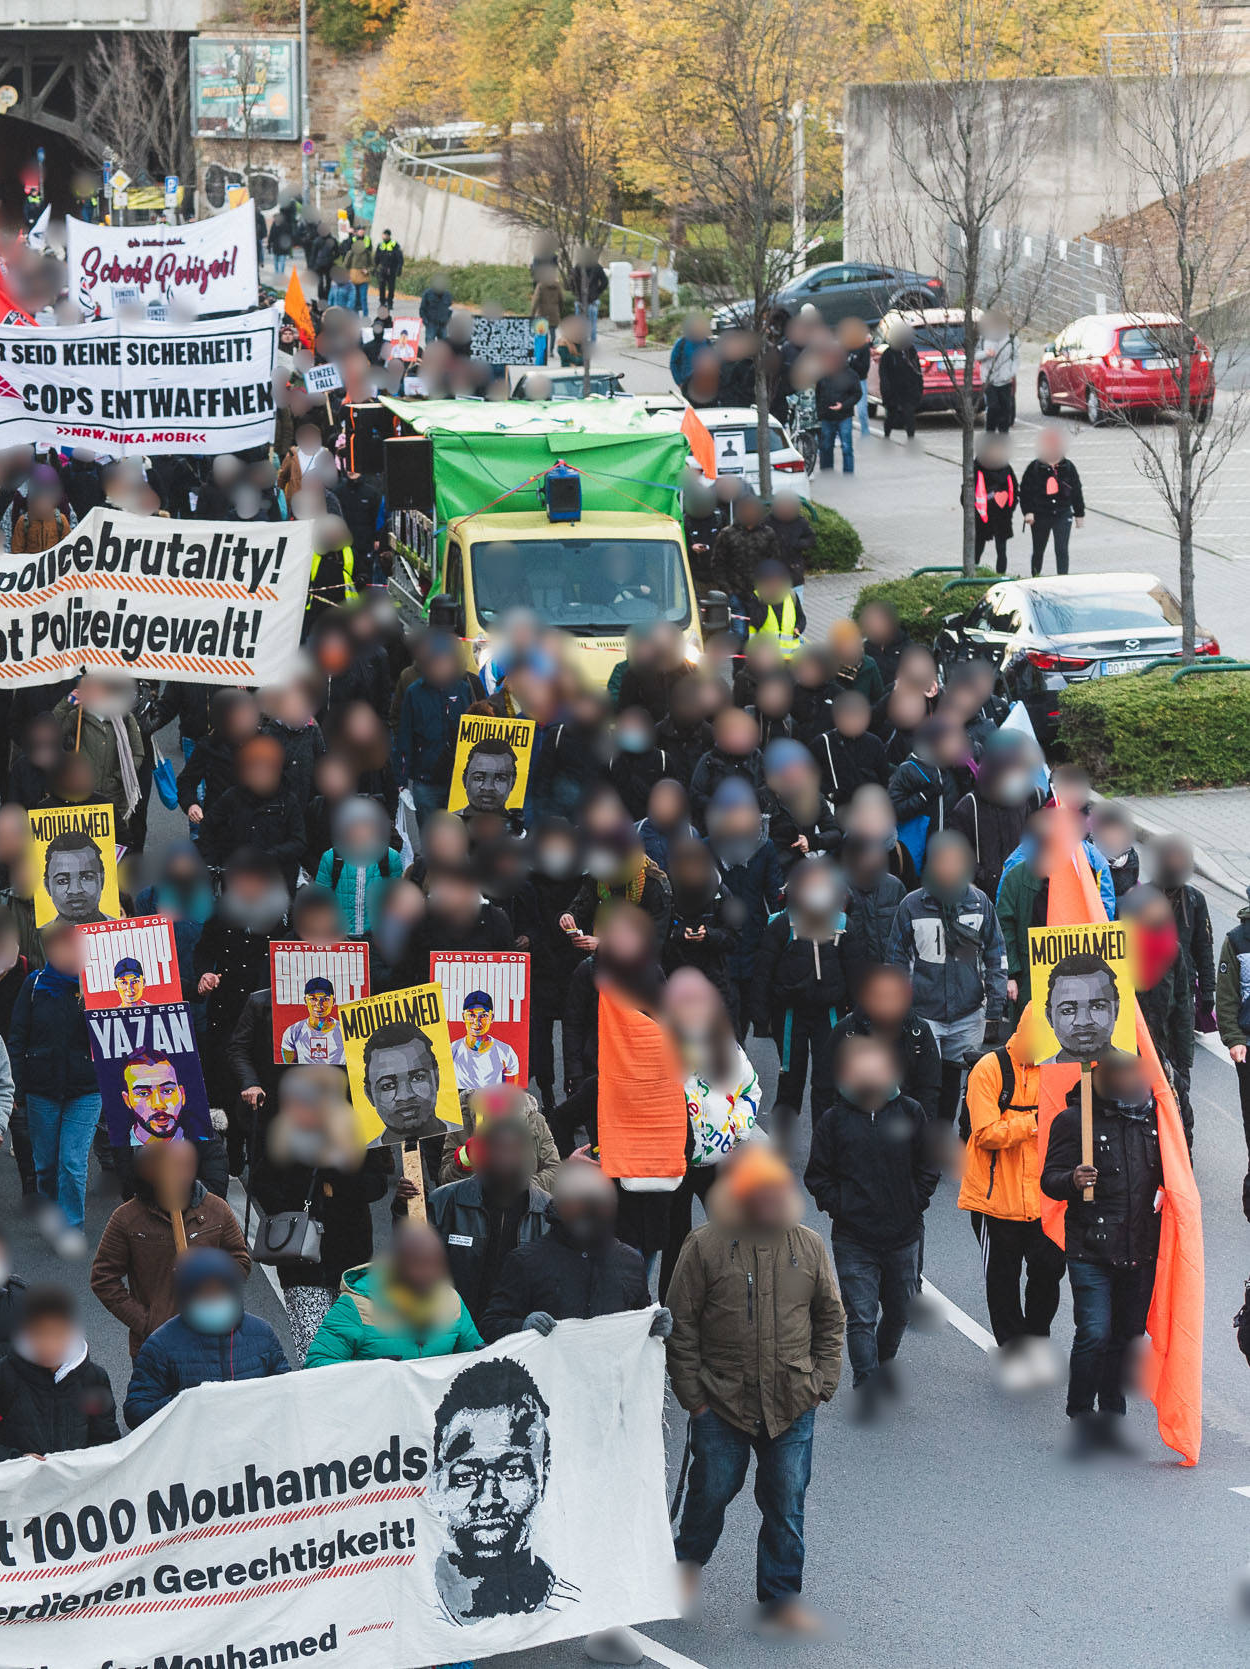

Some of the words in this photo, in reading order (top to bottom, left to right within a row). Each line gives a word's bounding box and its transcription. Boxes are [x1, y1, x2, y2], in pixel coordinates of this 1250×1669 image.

[12, 344, 56, 366] SEID
[62, 342, 121, 366] KEINE
[127, 337, 253, 366] SICHERHEIT!
[308, 366, 336, 382] EINZEL
[315, 378, 335, 390] FALL
[22, 383, 94, 415] COPS
[101, 381, 275, 419] ENTWAFFNEN
[96, 521, 288, 594] brutality!
[31, 597, 263, 662] Polizeigewalt!
[459, 721, 530, 748] MOUHAMED
[31, 811, 110, 842] MOUHAMED
[81, 921, 137, 934] JUSTICE
[143, 917, 168, 927] FOR
[1046, 927, 1089, 935] JUSTICE
[501, 954, 526, 962] FOR
[1031, 930, 1126, 966] MOUHAMED
[356, 993, 399, 1005] JUSTICE
[405, 987, 424, 996] FOR
[91, 1007, 151, 1018] JUSTICE
[160, 1004, 185, 1014] FOR
[340, 992, 441, 1041] MOUHAMED
[23, 1498, 136, 1562] 1000
[149, 1434, 429, 1535] Mouhameds
[153, 1518, 416, 1594] Gerechtigkeit!
